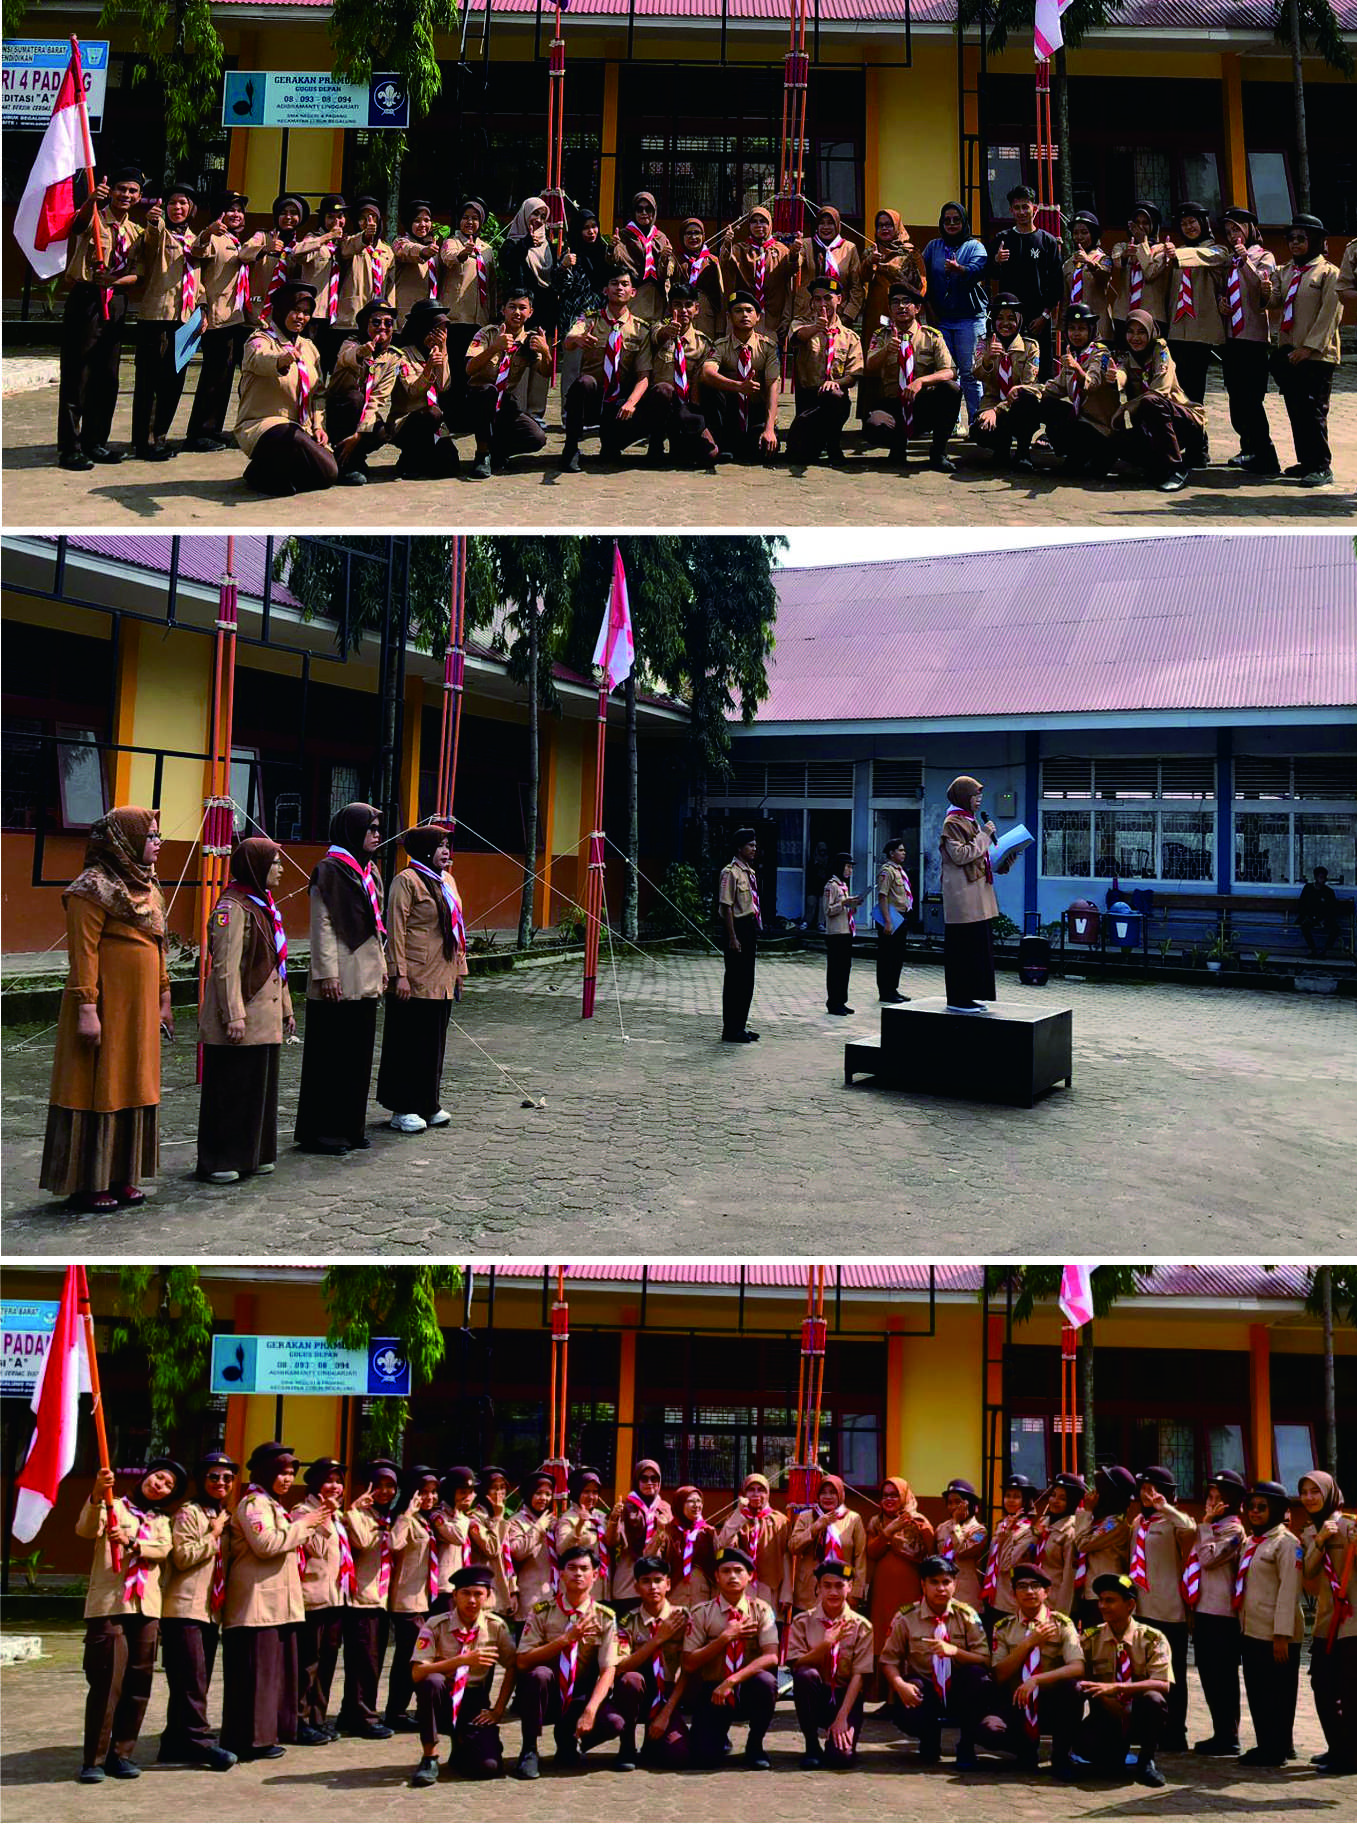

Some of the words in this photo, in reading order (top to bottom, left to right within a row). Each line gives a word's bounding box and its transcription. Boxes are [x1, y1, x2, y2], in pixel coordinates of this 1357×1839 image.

[19, 70, 28, 90] 4
[32, 70, 92, 93] PADG
[274, 76, 317, 84] GERAKAN
[299, 95, 314, 103] 093
[337, 95, 352, 103] 094
[4, 1333, 51, 1356] PADA
[266, 1341, 312, 1349] GERAKAN
